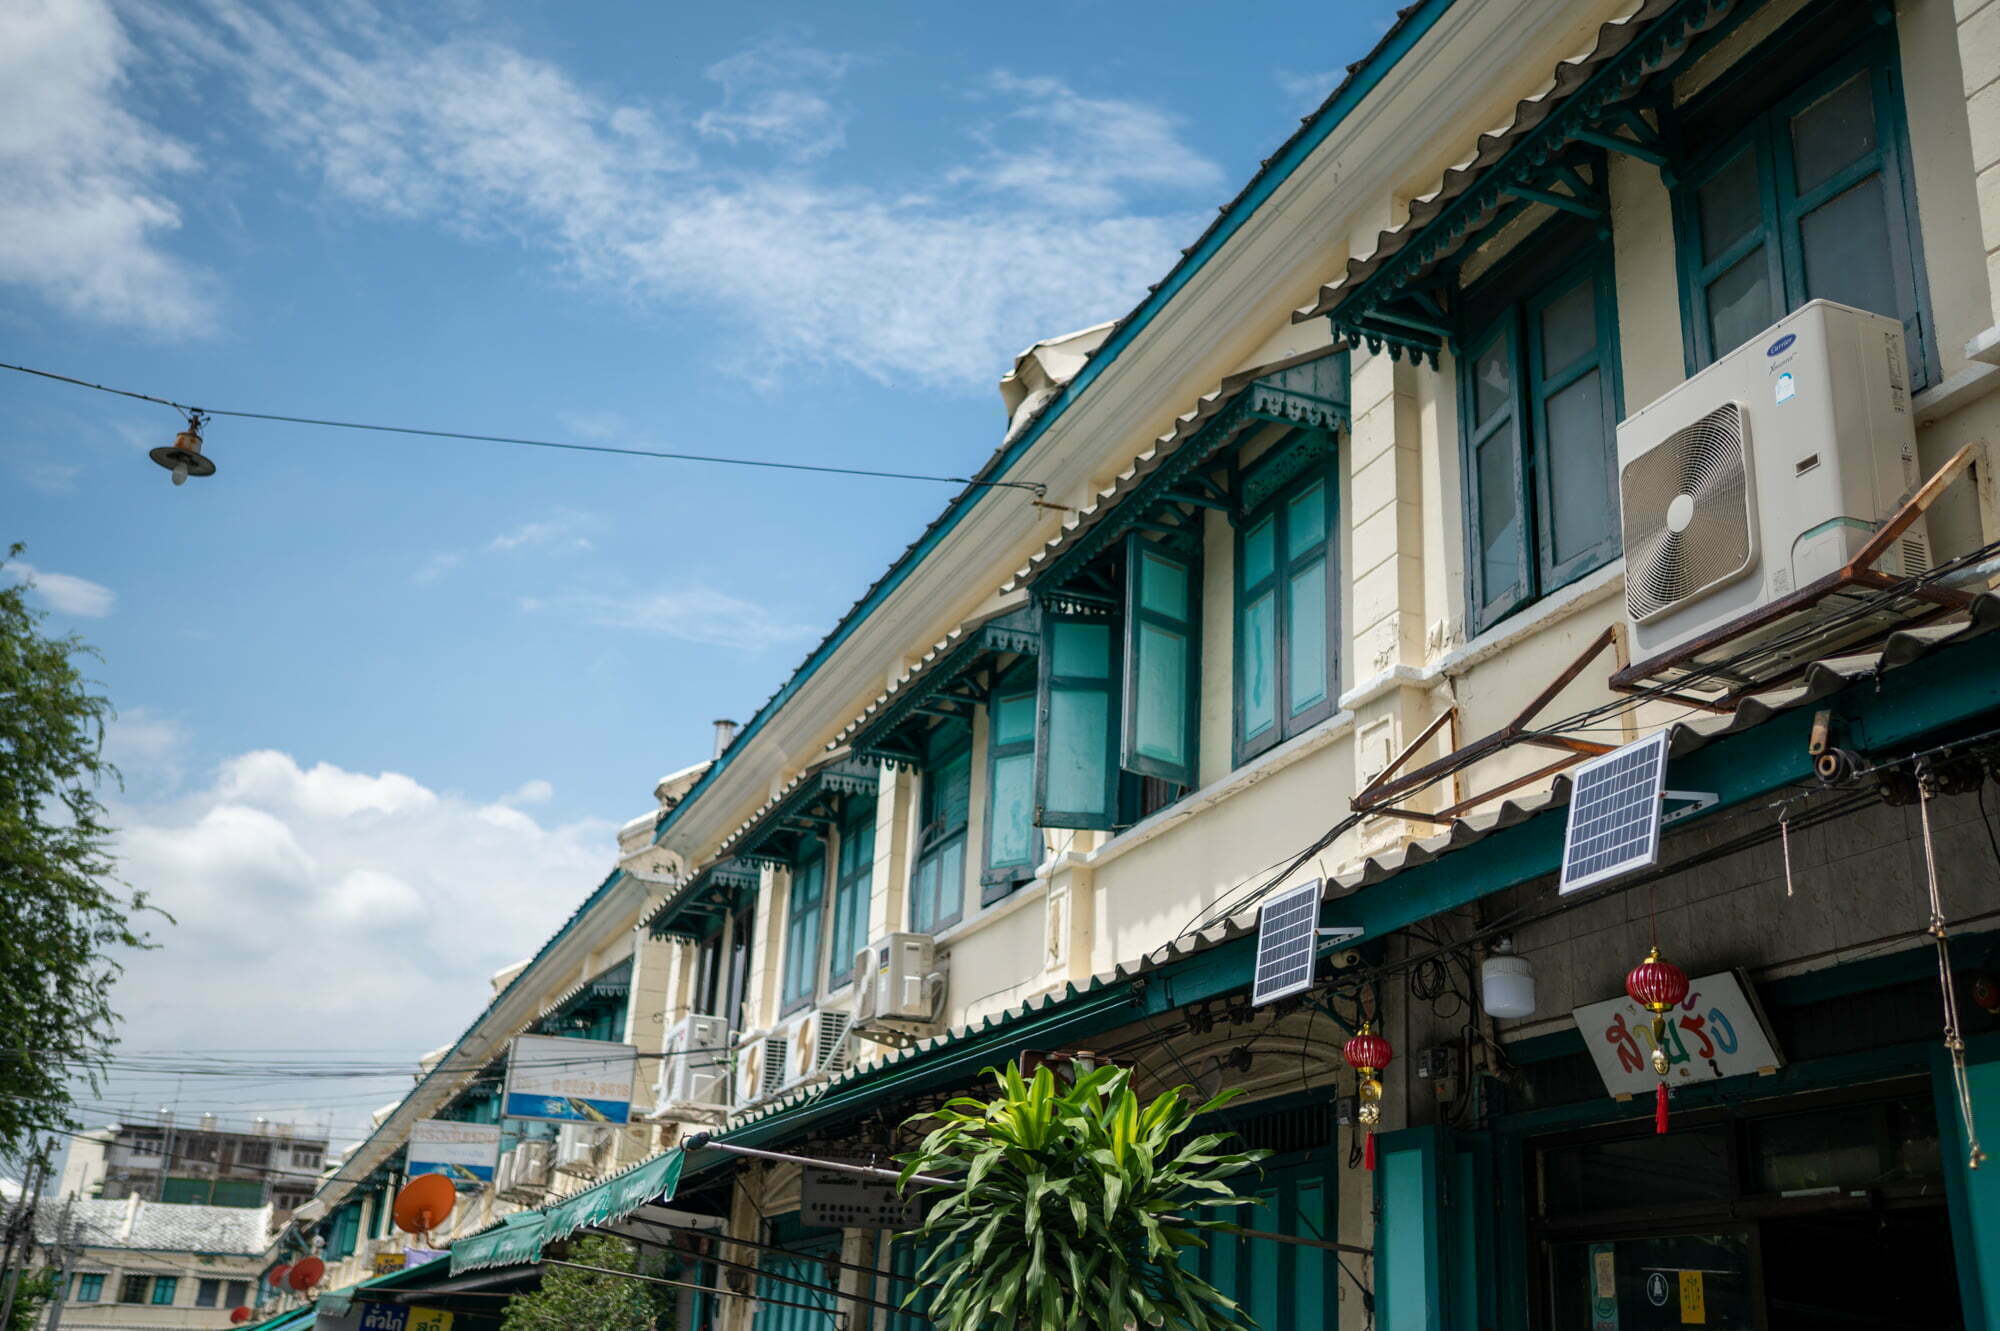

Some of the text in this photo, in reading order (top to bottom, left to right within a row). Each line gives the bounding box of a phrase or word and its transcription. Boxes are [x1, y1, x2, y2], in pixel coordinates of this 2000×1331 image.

[1769, 335, 1794, 356] Carrier
[1606, 993, 1738, 1077] สายรุ้ง
[364, 1303, 405, 1331] คั่วไก่
